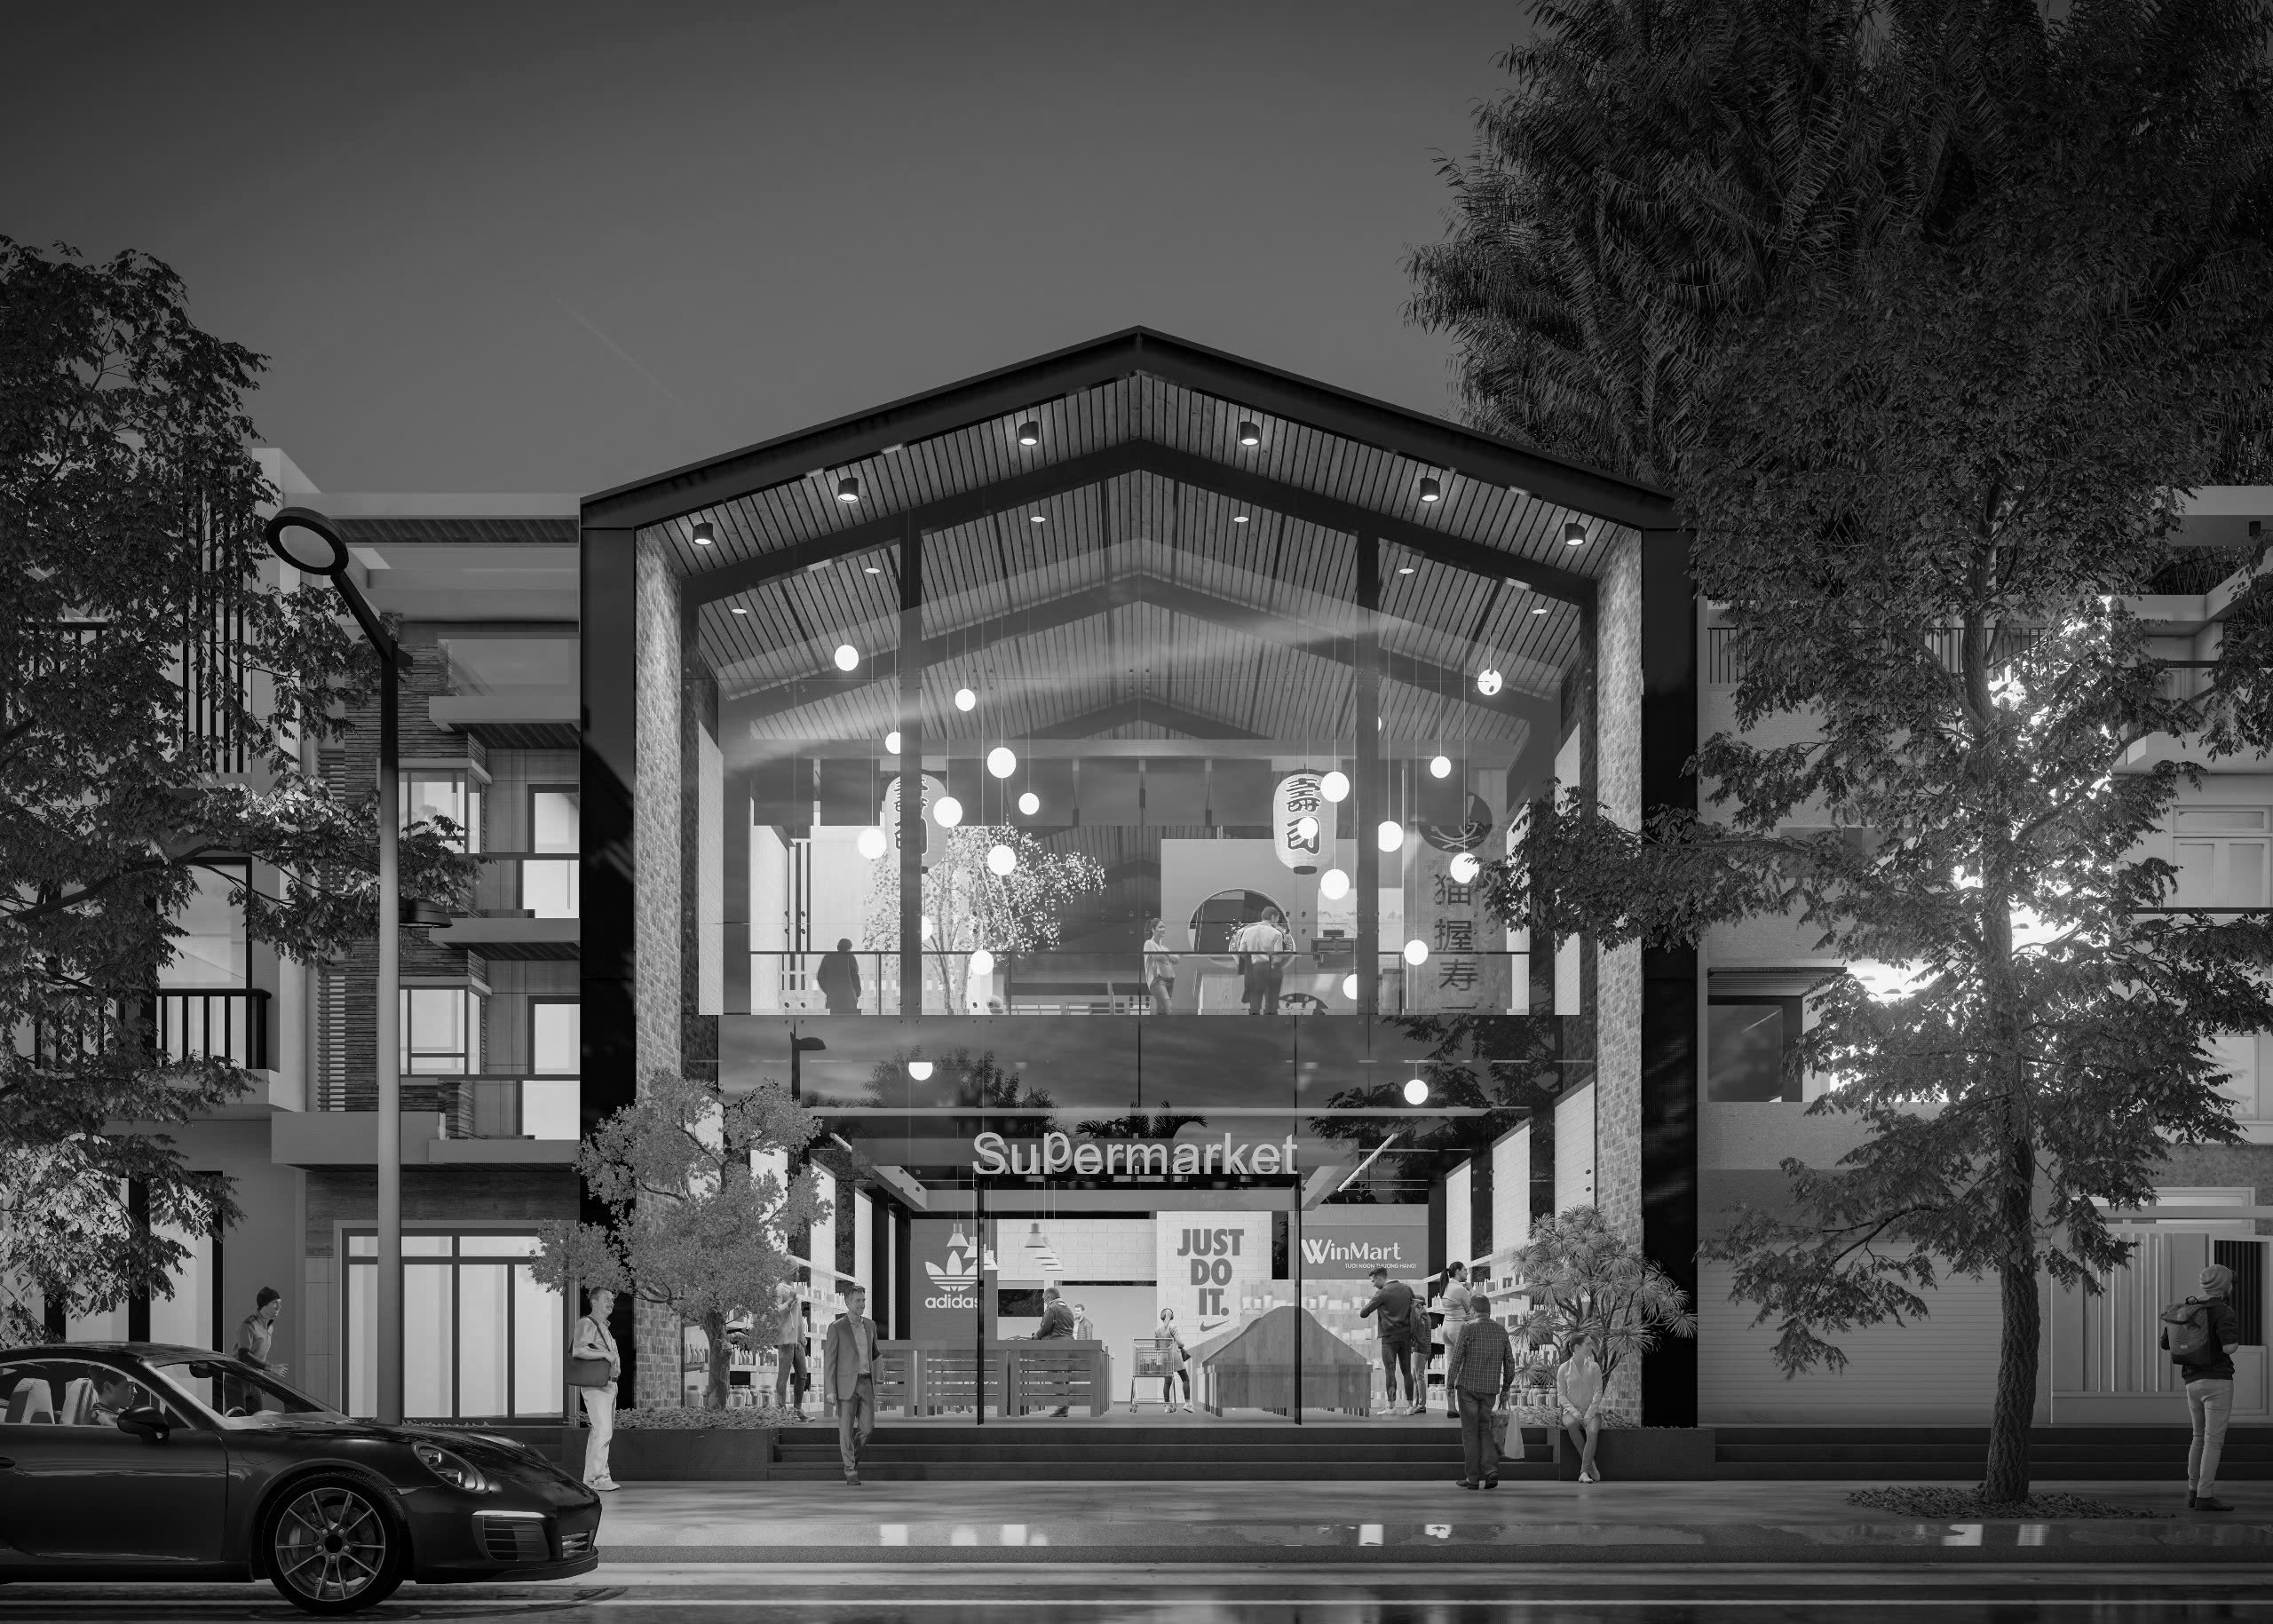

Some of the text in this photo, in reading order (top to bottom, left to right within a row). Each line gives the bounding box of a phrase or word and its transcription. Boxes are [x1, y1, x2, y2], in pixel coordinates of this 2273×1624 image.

[972, 1131, 1297, 1175] Supermarket
[1176, 1228, 1245, 1256] JUST
[1301, 1239, 1402, 1264] WinMart
[1190, 1257, 1233, 1287] DO
[1198, 1287, 1230, 1317] IT.
